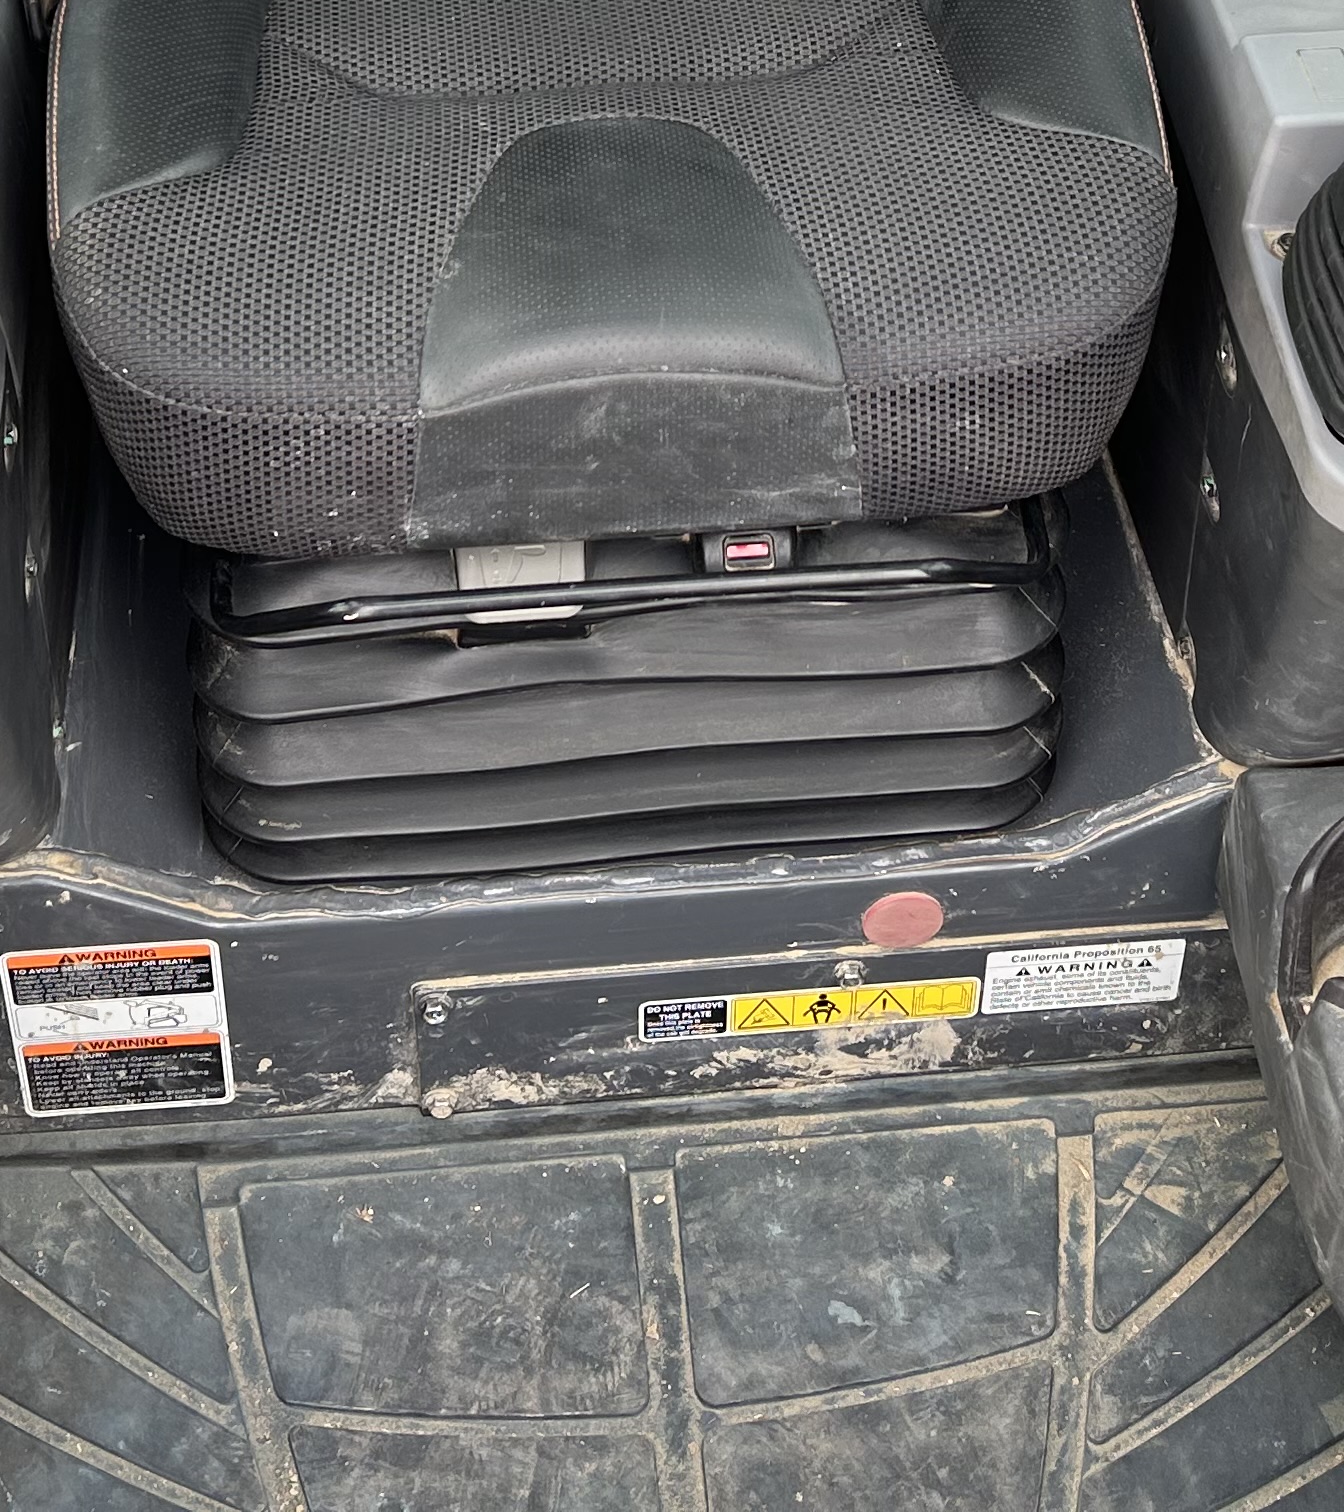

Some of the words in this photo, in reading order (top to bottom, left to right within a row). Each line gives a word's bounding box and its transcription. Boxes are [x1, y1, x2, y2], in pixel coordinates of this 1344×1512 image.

[75, 948, 157, 963] WARNING
[1011, 951, 1070, 963] California
[1073, 946, 1144, 959] Proposition
[1147, 945, 1162, 953] 65
[1037, 959, 1133, 974] WARNING
[647, 1006, 661, 1014] DO
[684, 1001, 724, 1011] REMOVE
[659, 1012, 680, 1021] THIS
[681, 1010, 712, 1019] PLATE
[89, 1036, 168, 1050] WARNING
